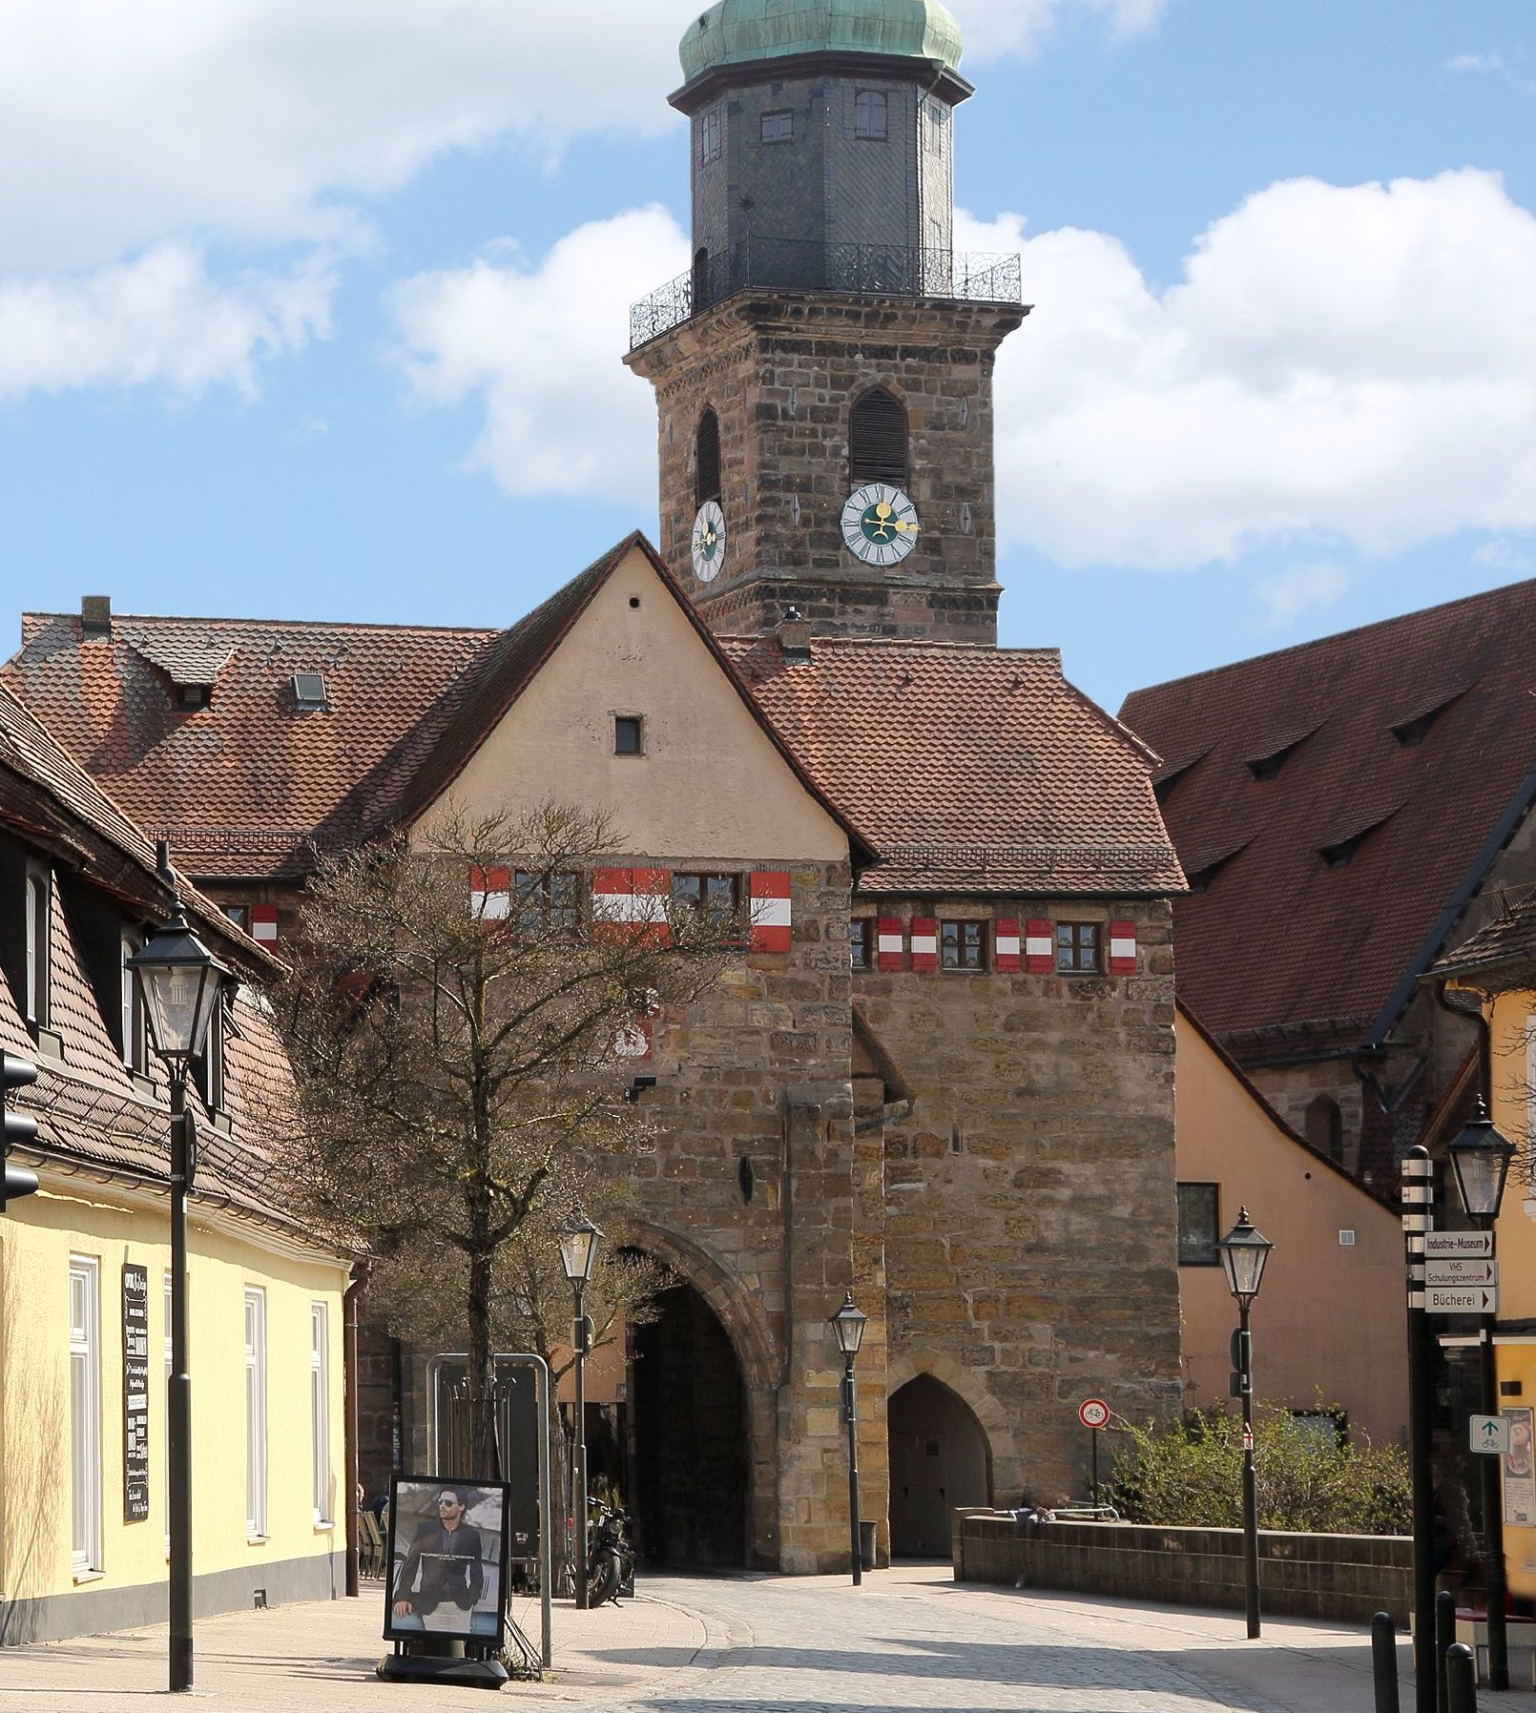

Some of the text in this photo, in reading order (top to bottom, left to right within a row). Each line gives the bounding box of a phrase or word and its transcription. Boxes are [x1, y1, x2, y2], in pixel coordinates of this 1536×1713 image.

[1427, 1237, 1483, 1250] Industrie-Museum
[1449, 1263, 1462, 1271] VHS
[1428, 1273, 1485, 1284] Schulungszentrum
[1433, 1293, 1475, 1306] Bücherei
